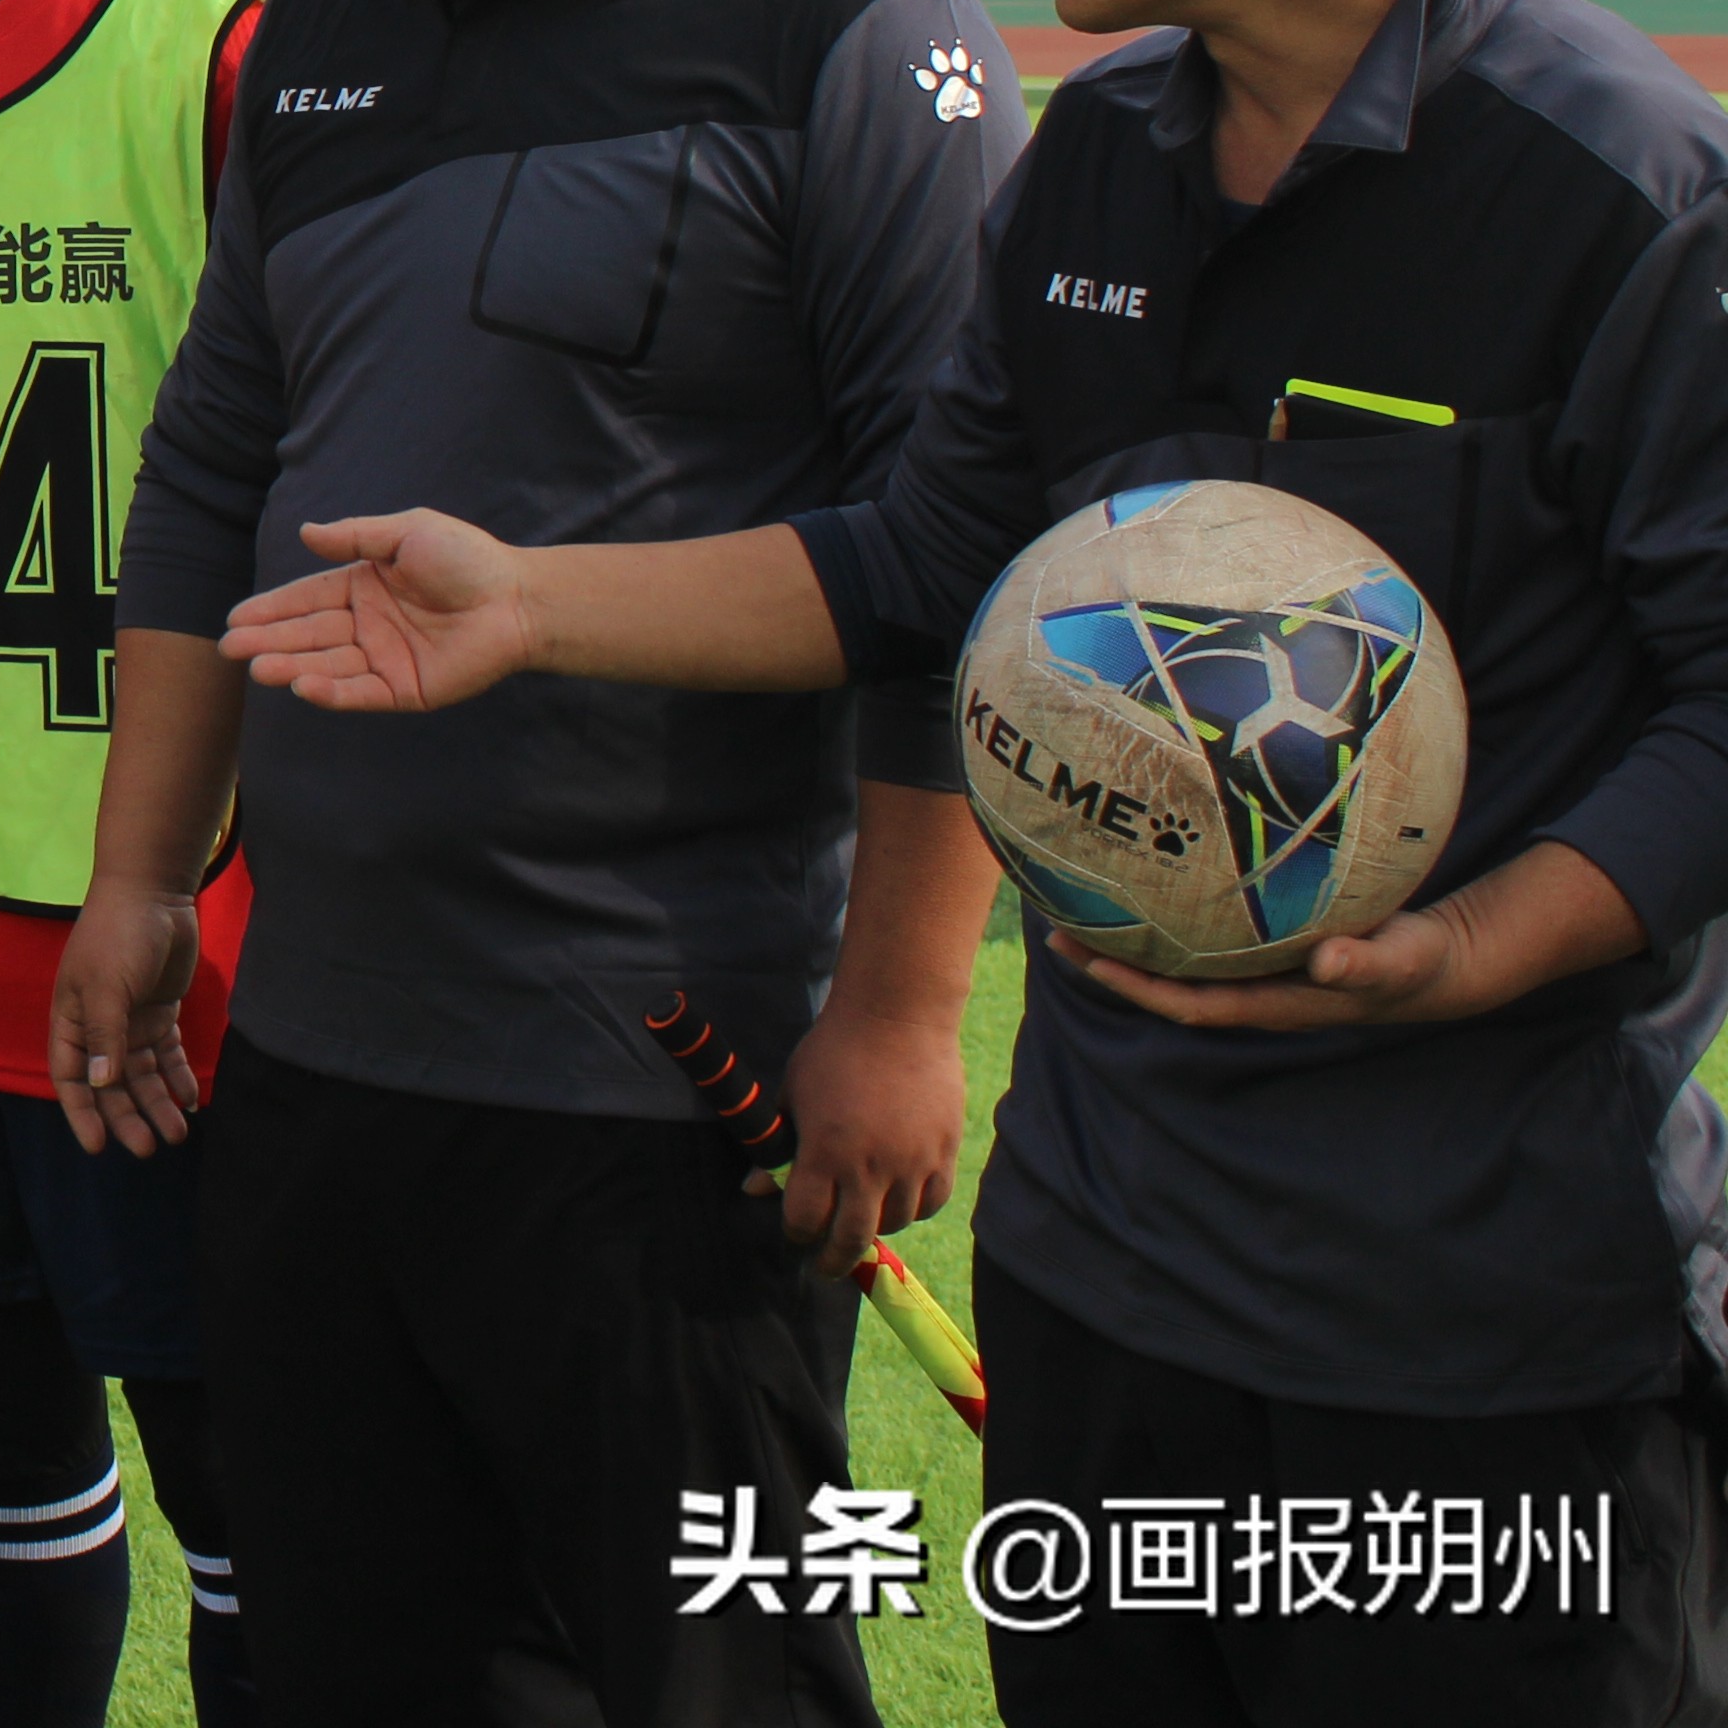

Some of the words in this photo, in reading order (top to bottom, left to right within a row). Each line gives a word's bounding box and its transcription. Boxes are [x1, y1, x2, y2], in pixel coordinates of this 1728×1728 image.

[275, 85, 384, 114] KELME
[1045, 272, 1148, 319] KELME
[964, 687, 1149, 843] KELME
